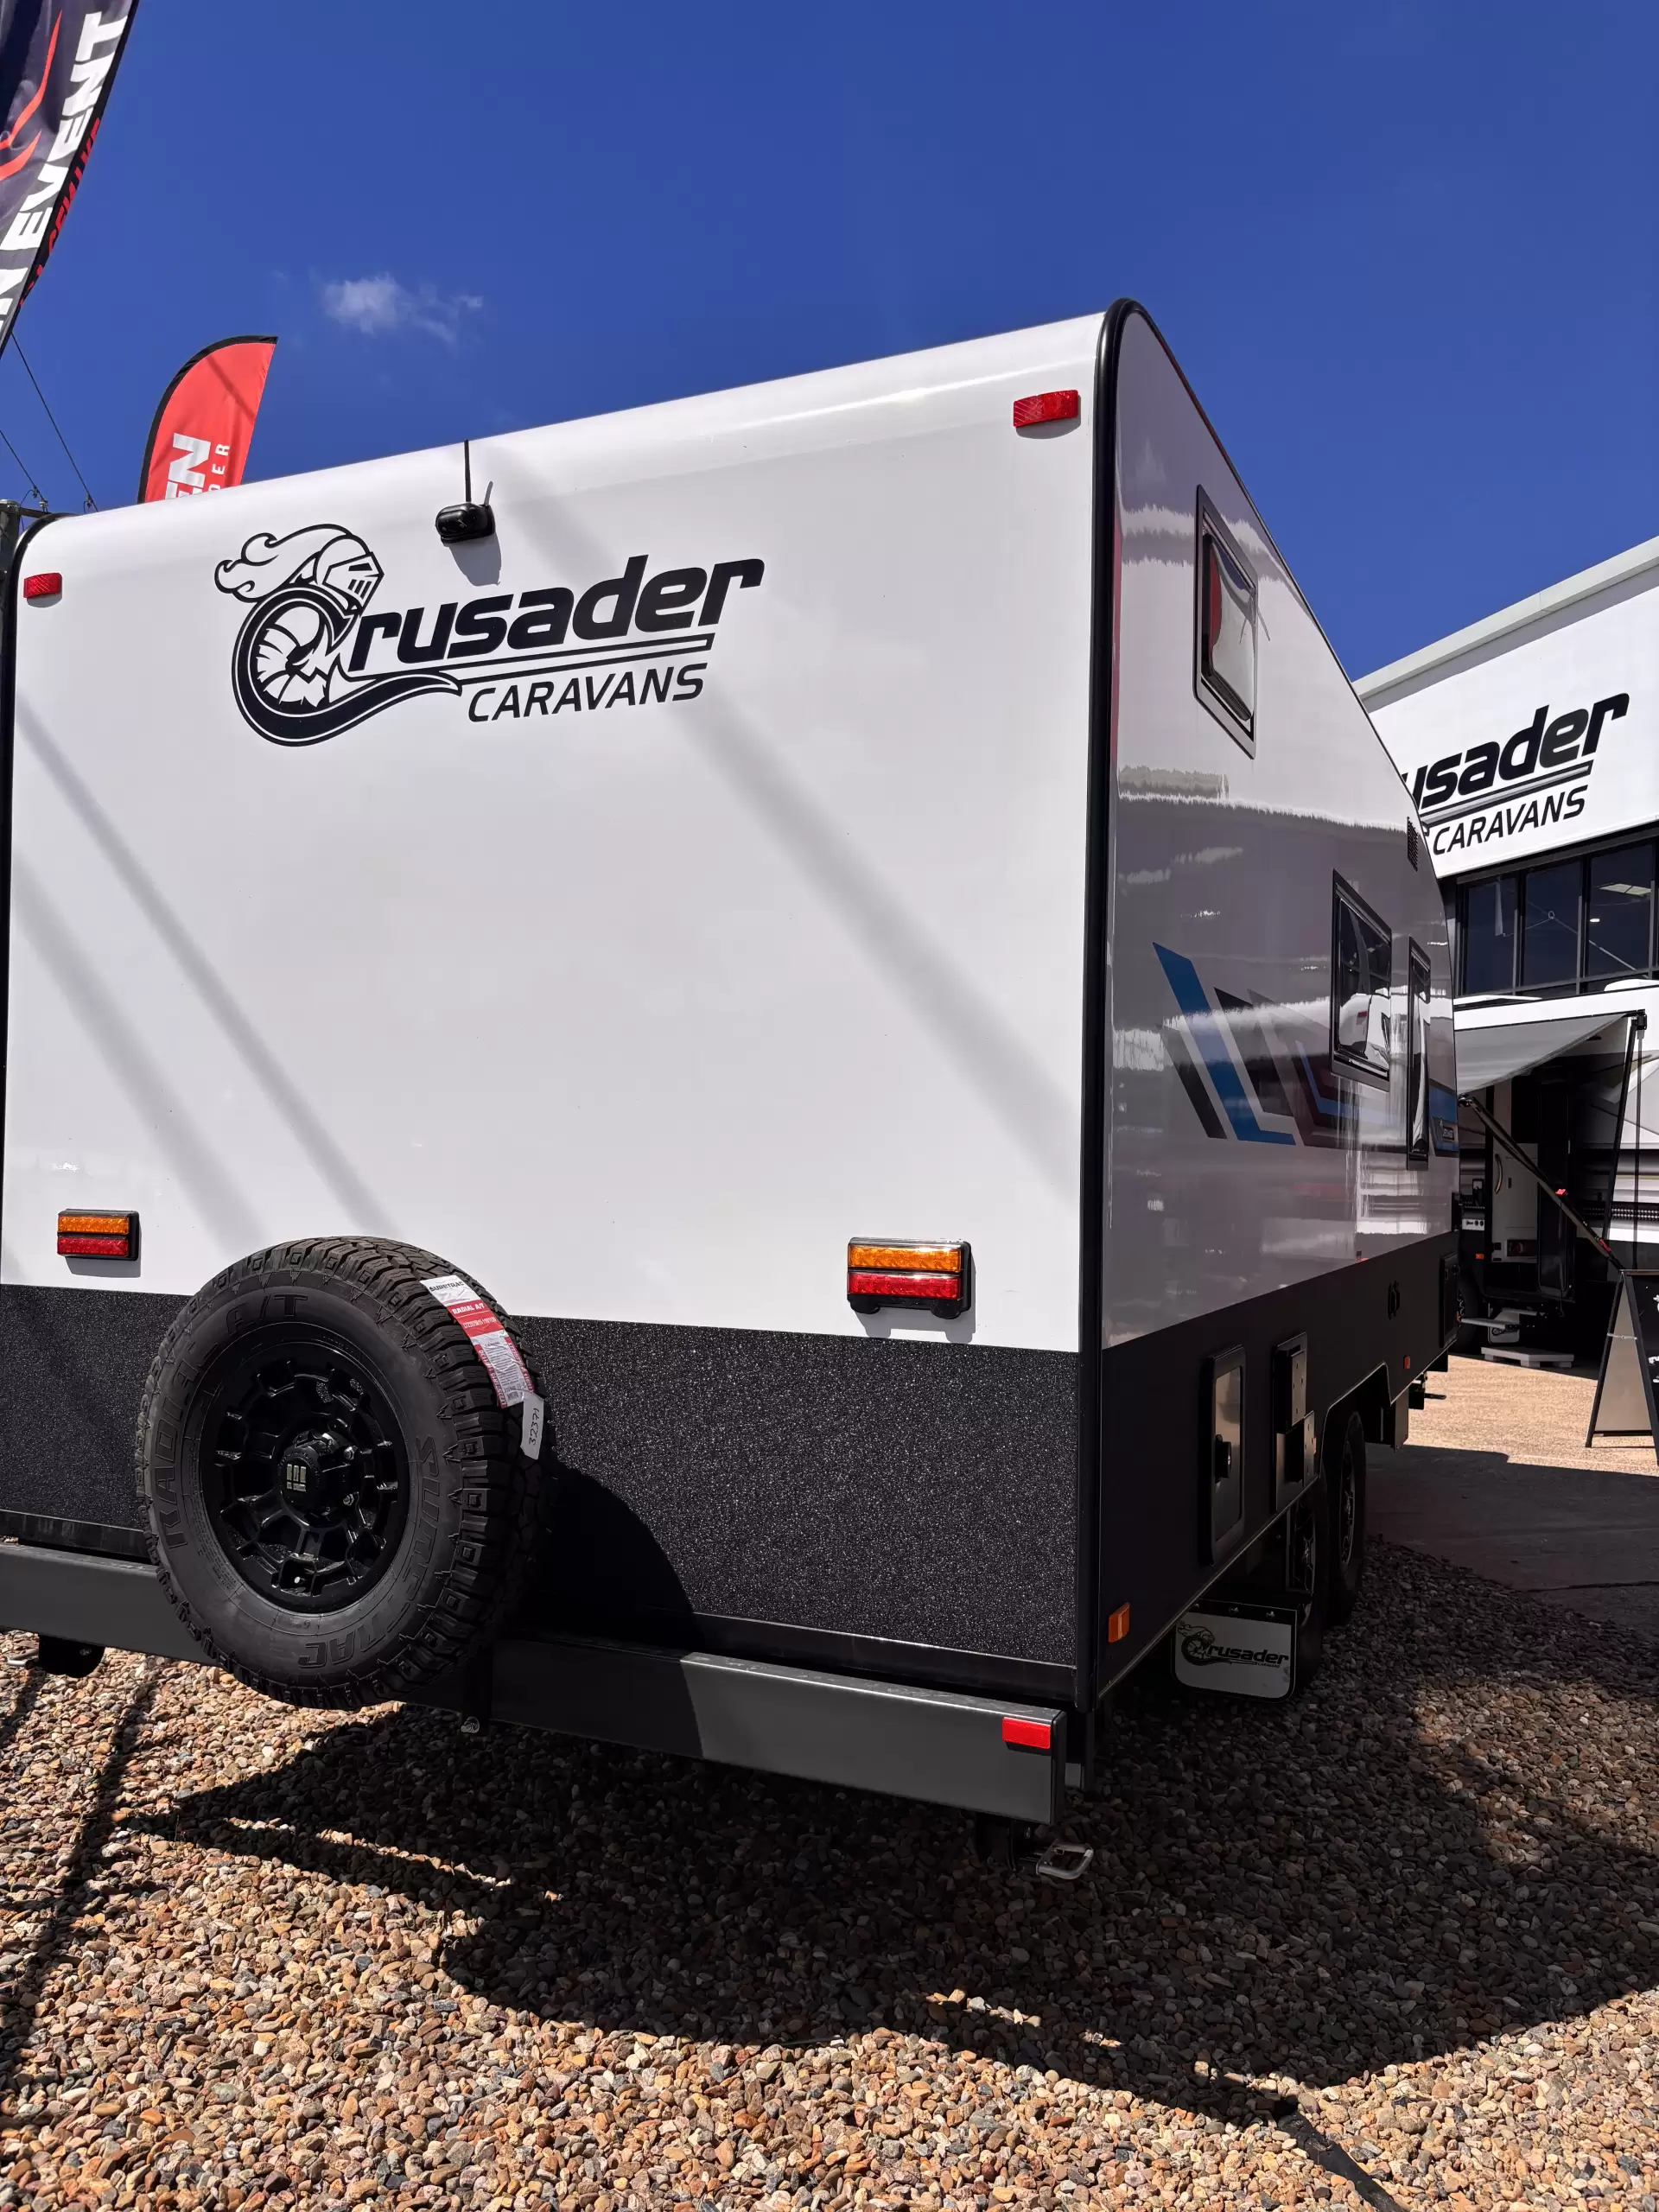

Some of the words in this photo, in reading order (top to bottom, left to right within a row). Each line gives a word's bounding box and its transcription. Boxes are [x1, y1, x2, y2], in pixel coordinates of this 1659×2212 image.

[0, 13, 129, 250] EVENT
[467, 662, 709, 722] CARAVANS
[1402, 692, 1630, 810] usader
[1433, 784, 1589, 855] CARAVANS
[451, 1305, 474, 1315] RADIAL
[154, 1342, 218, 1550] RADIAL
[226, 1294, 309, 1335] A/T
